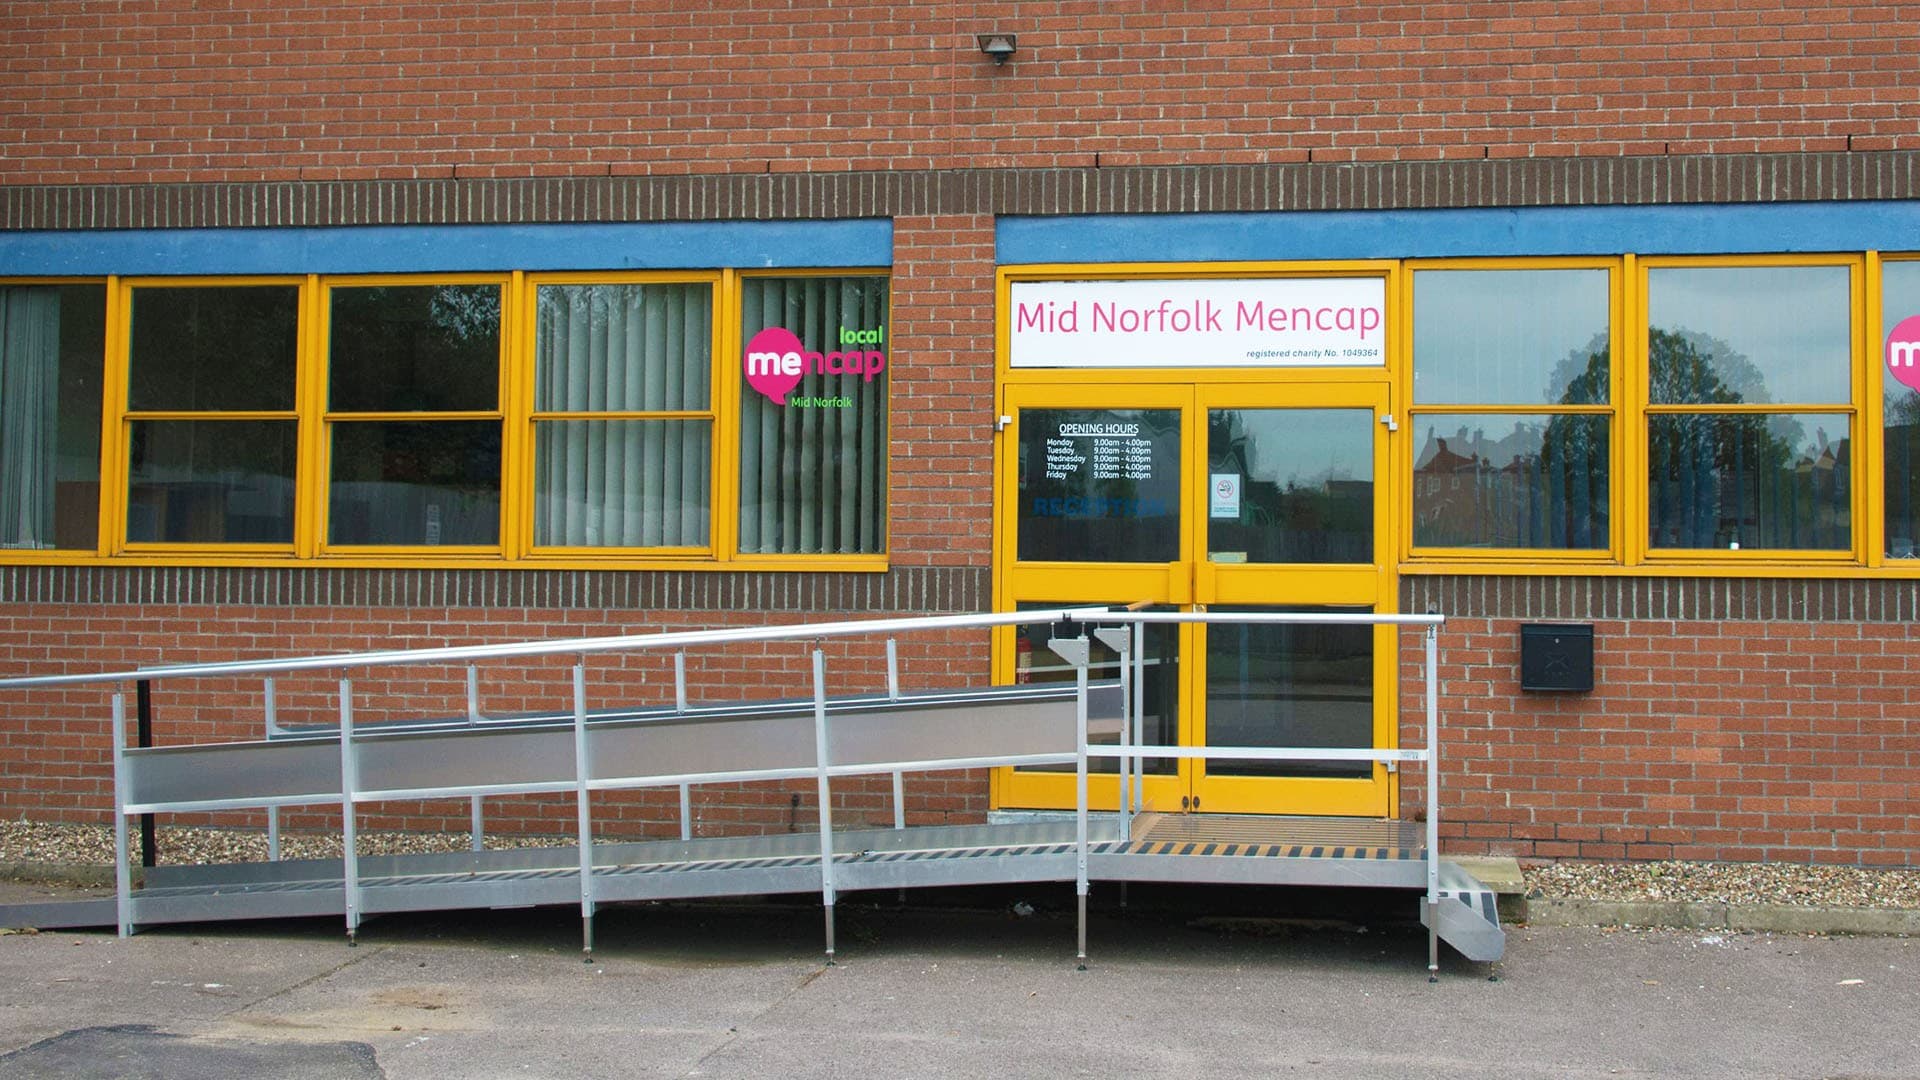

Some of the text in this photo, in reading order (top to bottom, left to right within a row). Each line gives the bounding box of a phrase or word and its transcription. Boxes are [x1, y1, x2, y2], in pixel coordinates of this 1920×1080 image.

[1017, 299, 1379, 340] Mid Norfolk Mencap
[839, 325, 883, 345] local
[1247, 349, 1290, 359] registered
[1292, 349, 1322, 360] charity
[1342, 349, 1378, 357] 1049364
[748, 350, 886, 383] mencap
[791, 396, 852, 408] Mid Norfolk
[1059, 423, 1139, 434] OPENING HOURS
[1046, 439, 1074, 448] Monday
[1125, 439, 1151, 448] 4.00pm
[1047, 447, 1075, 456] Tuesday
[1125, 447, 1151, 456] 4.00pm
[1047, 455, 1087, 465] Wednesday
[1125, 455, 1151, 465] 4.00pm
[1047, 463, 1078, 473] Thursday
[1125, 463, 1151, 473] 4.00pm
[1046, 471, 1067, 480] Friday
[1125, 471, 1151, 480] 4.00pm
